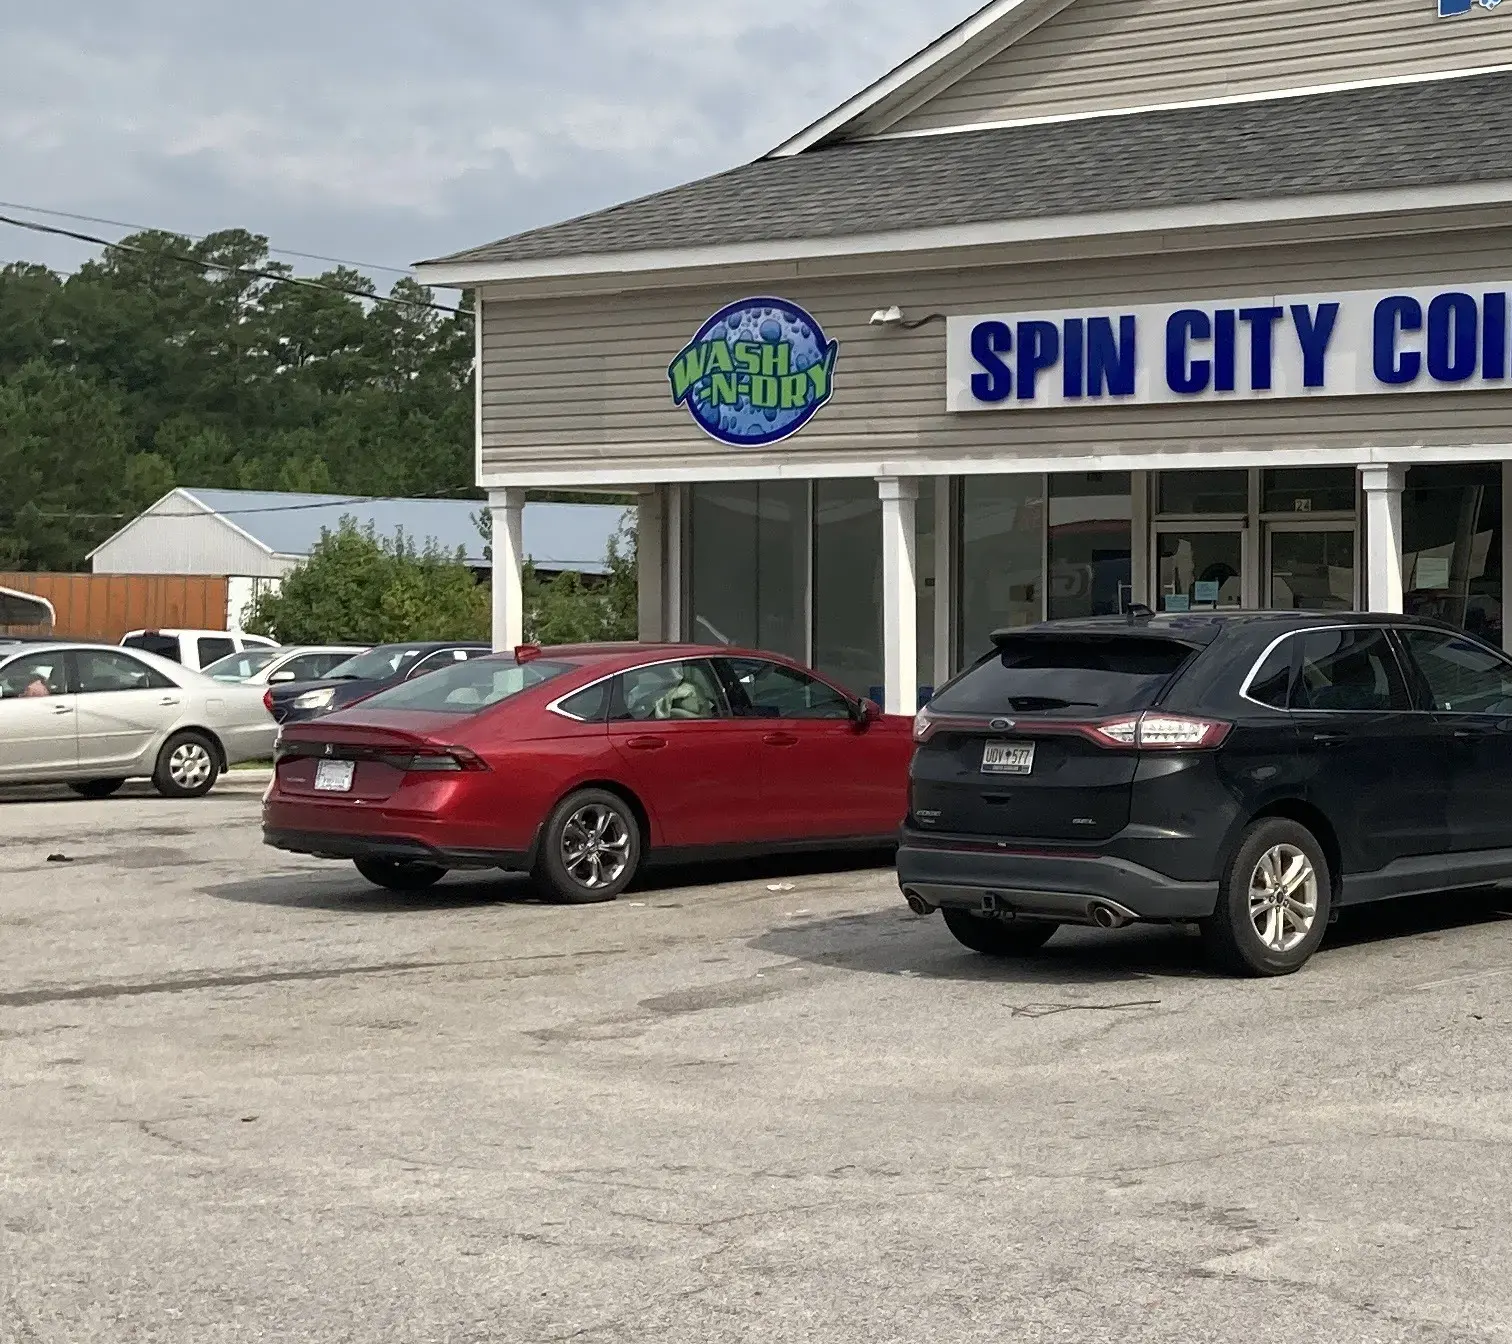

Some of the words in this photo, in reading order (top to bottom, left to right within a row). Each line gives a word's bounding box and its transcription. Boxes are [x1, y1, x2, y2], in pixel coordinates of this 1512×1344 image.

[671, 340, 790, 399] WASH
[972, 316, 1136, 400] SPIN
[1165, 304, 1338, 392] CITY
[1011, 748, 1031, 765] 577
